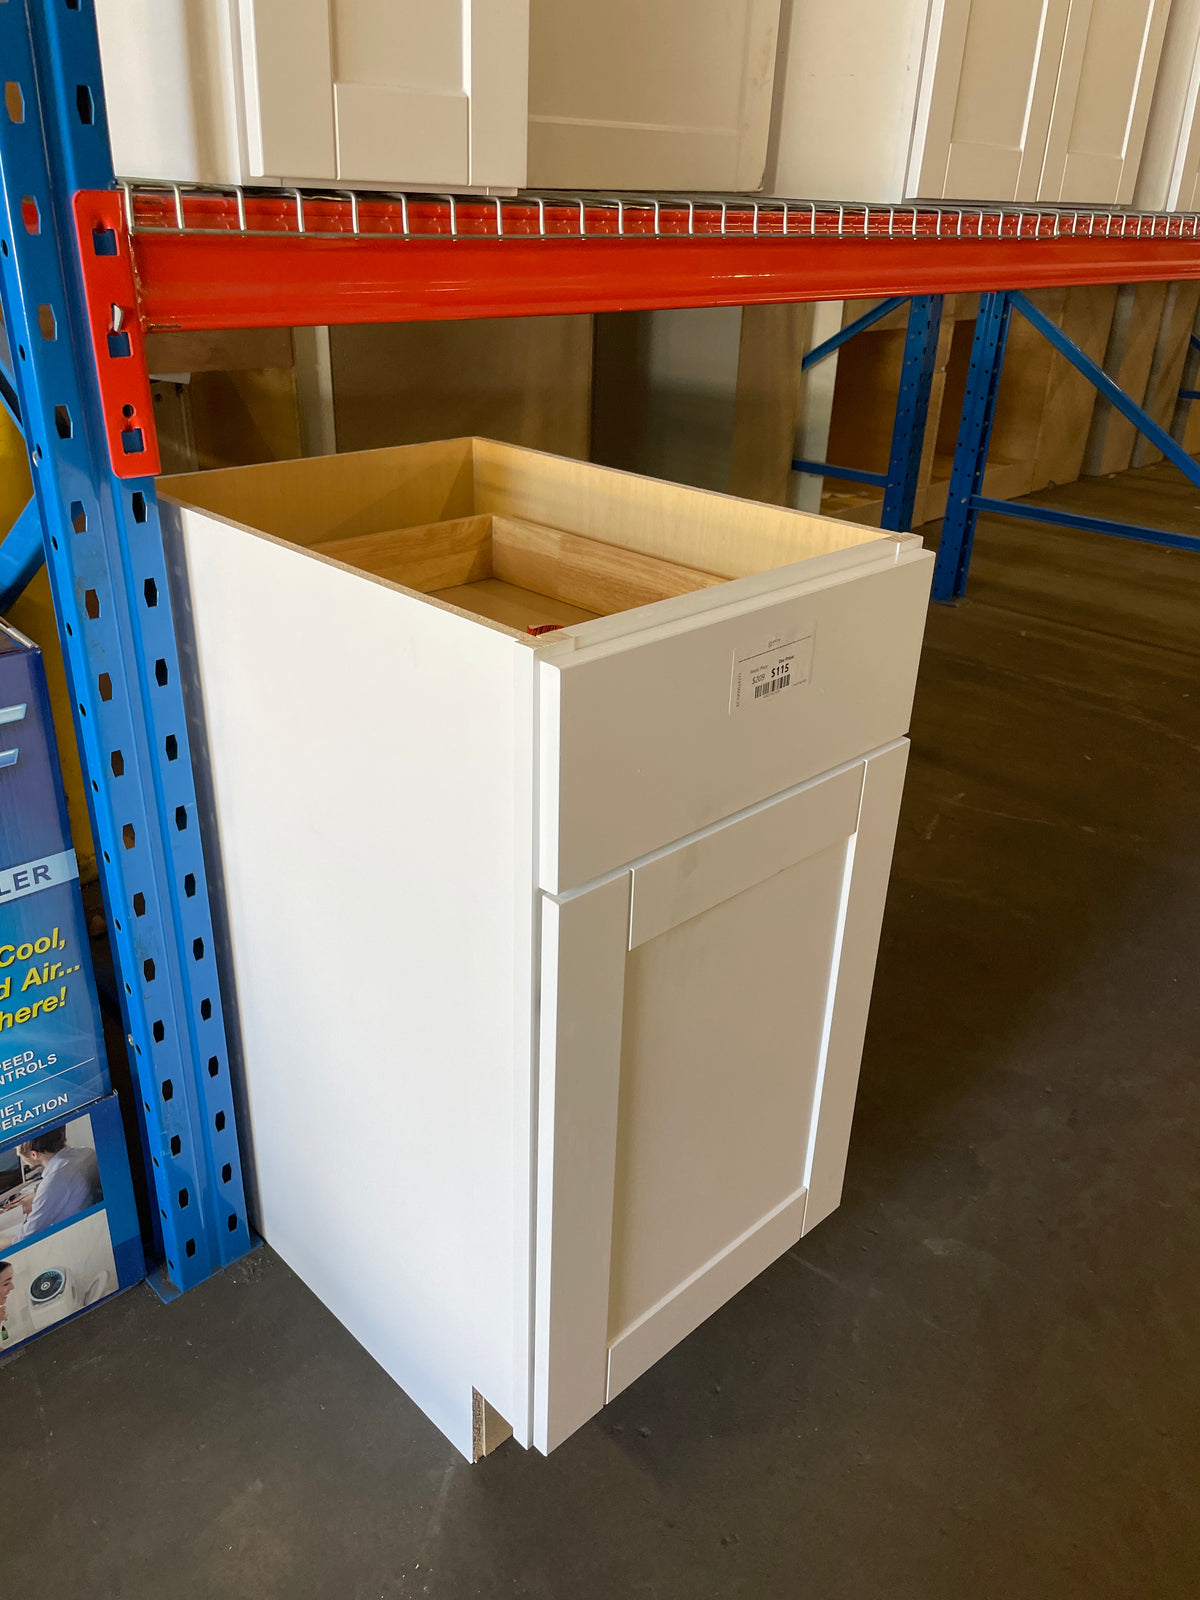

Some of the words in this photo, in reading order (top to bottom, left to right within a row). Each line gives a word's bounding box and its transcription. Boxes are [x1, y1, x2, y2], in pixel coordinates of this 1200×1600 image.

[771, 662, 789, 678] $115
[0, 927, 66, 968] Cool,
[21, 961, 80, 992] Air...
[0, 986, 66, 1031] here!
[0, 1050, 34, 1071] EED
[0, 1093, 68, 1130] ERATION
